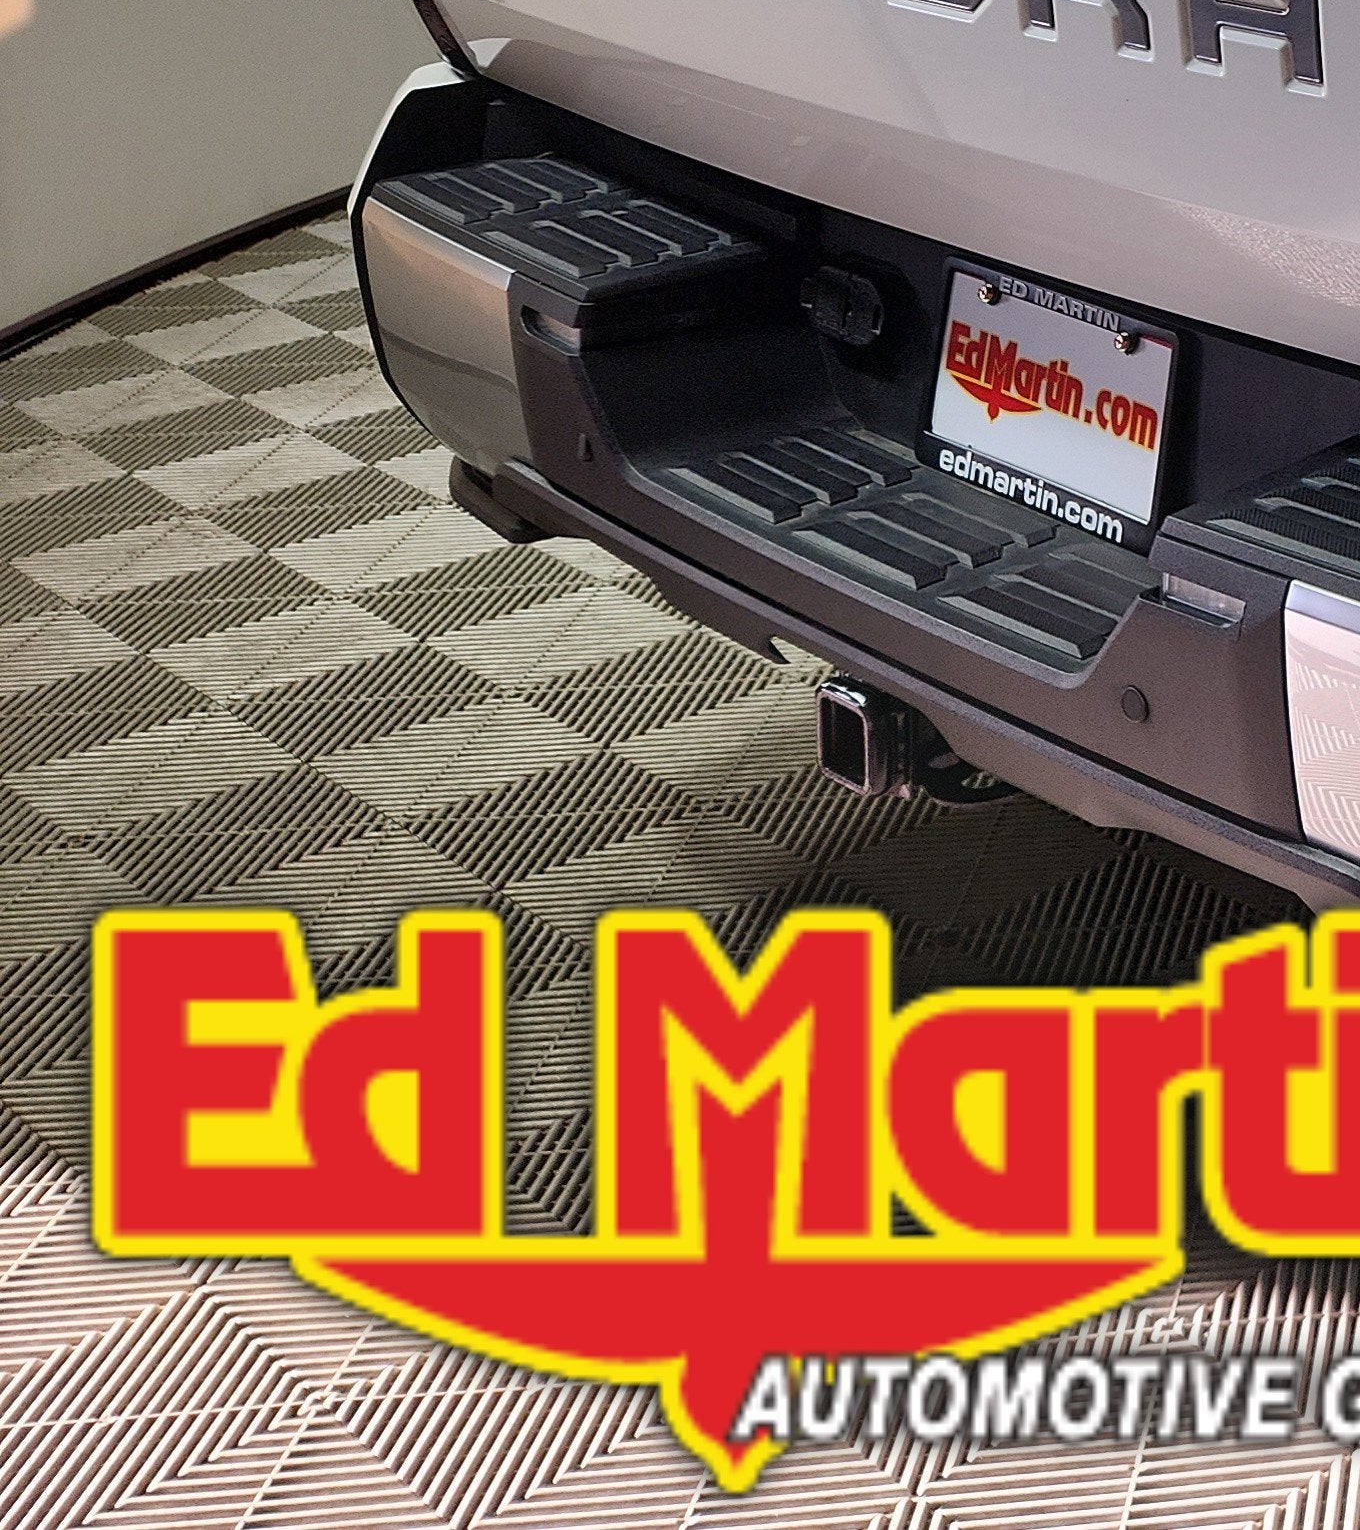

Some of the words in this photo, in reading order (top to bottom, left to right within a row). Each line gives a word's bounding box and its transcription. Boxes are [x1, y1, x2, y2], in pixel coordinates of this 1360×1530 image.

[998, 275, 1029, 300] ED
[1034, 288, 1122, 331] MARTIN
[938, 447, 1123, 543] edmartin.com
